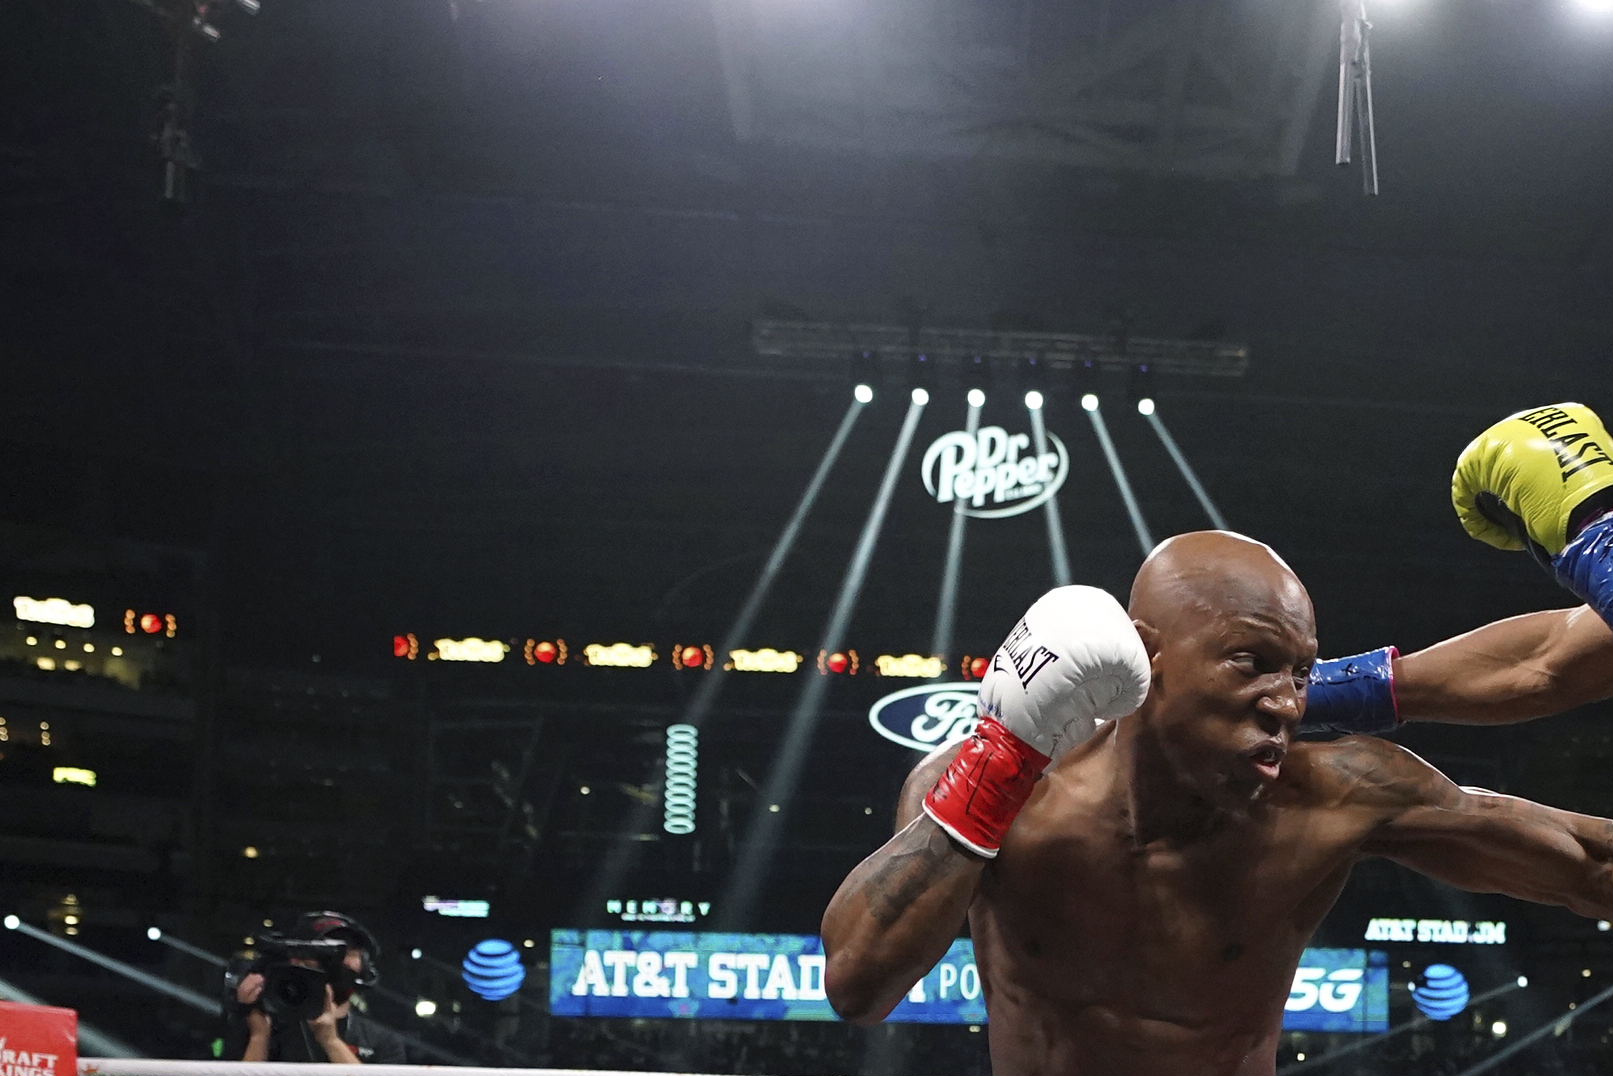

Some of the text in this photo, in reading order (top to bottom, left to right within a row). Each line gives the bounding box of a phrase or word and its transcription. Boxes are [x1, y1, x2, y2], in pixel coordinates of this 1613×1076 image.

[930, 431, 1059, 507] Pepper
[977, 426, 1030, 469] Dr
[1003, 617, 1059, 690] ERLAST
[911, 691, 981, 743] Fo
[572, 950, 698, 998] AT&T
[1284, 967, 1364, 1012] 5G
